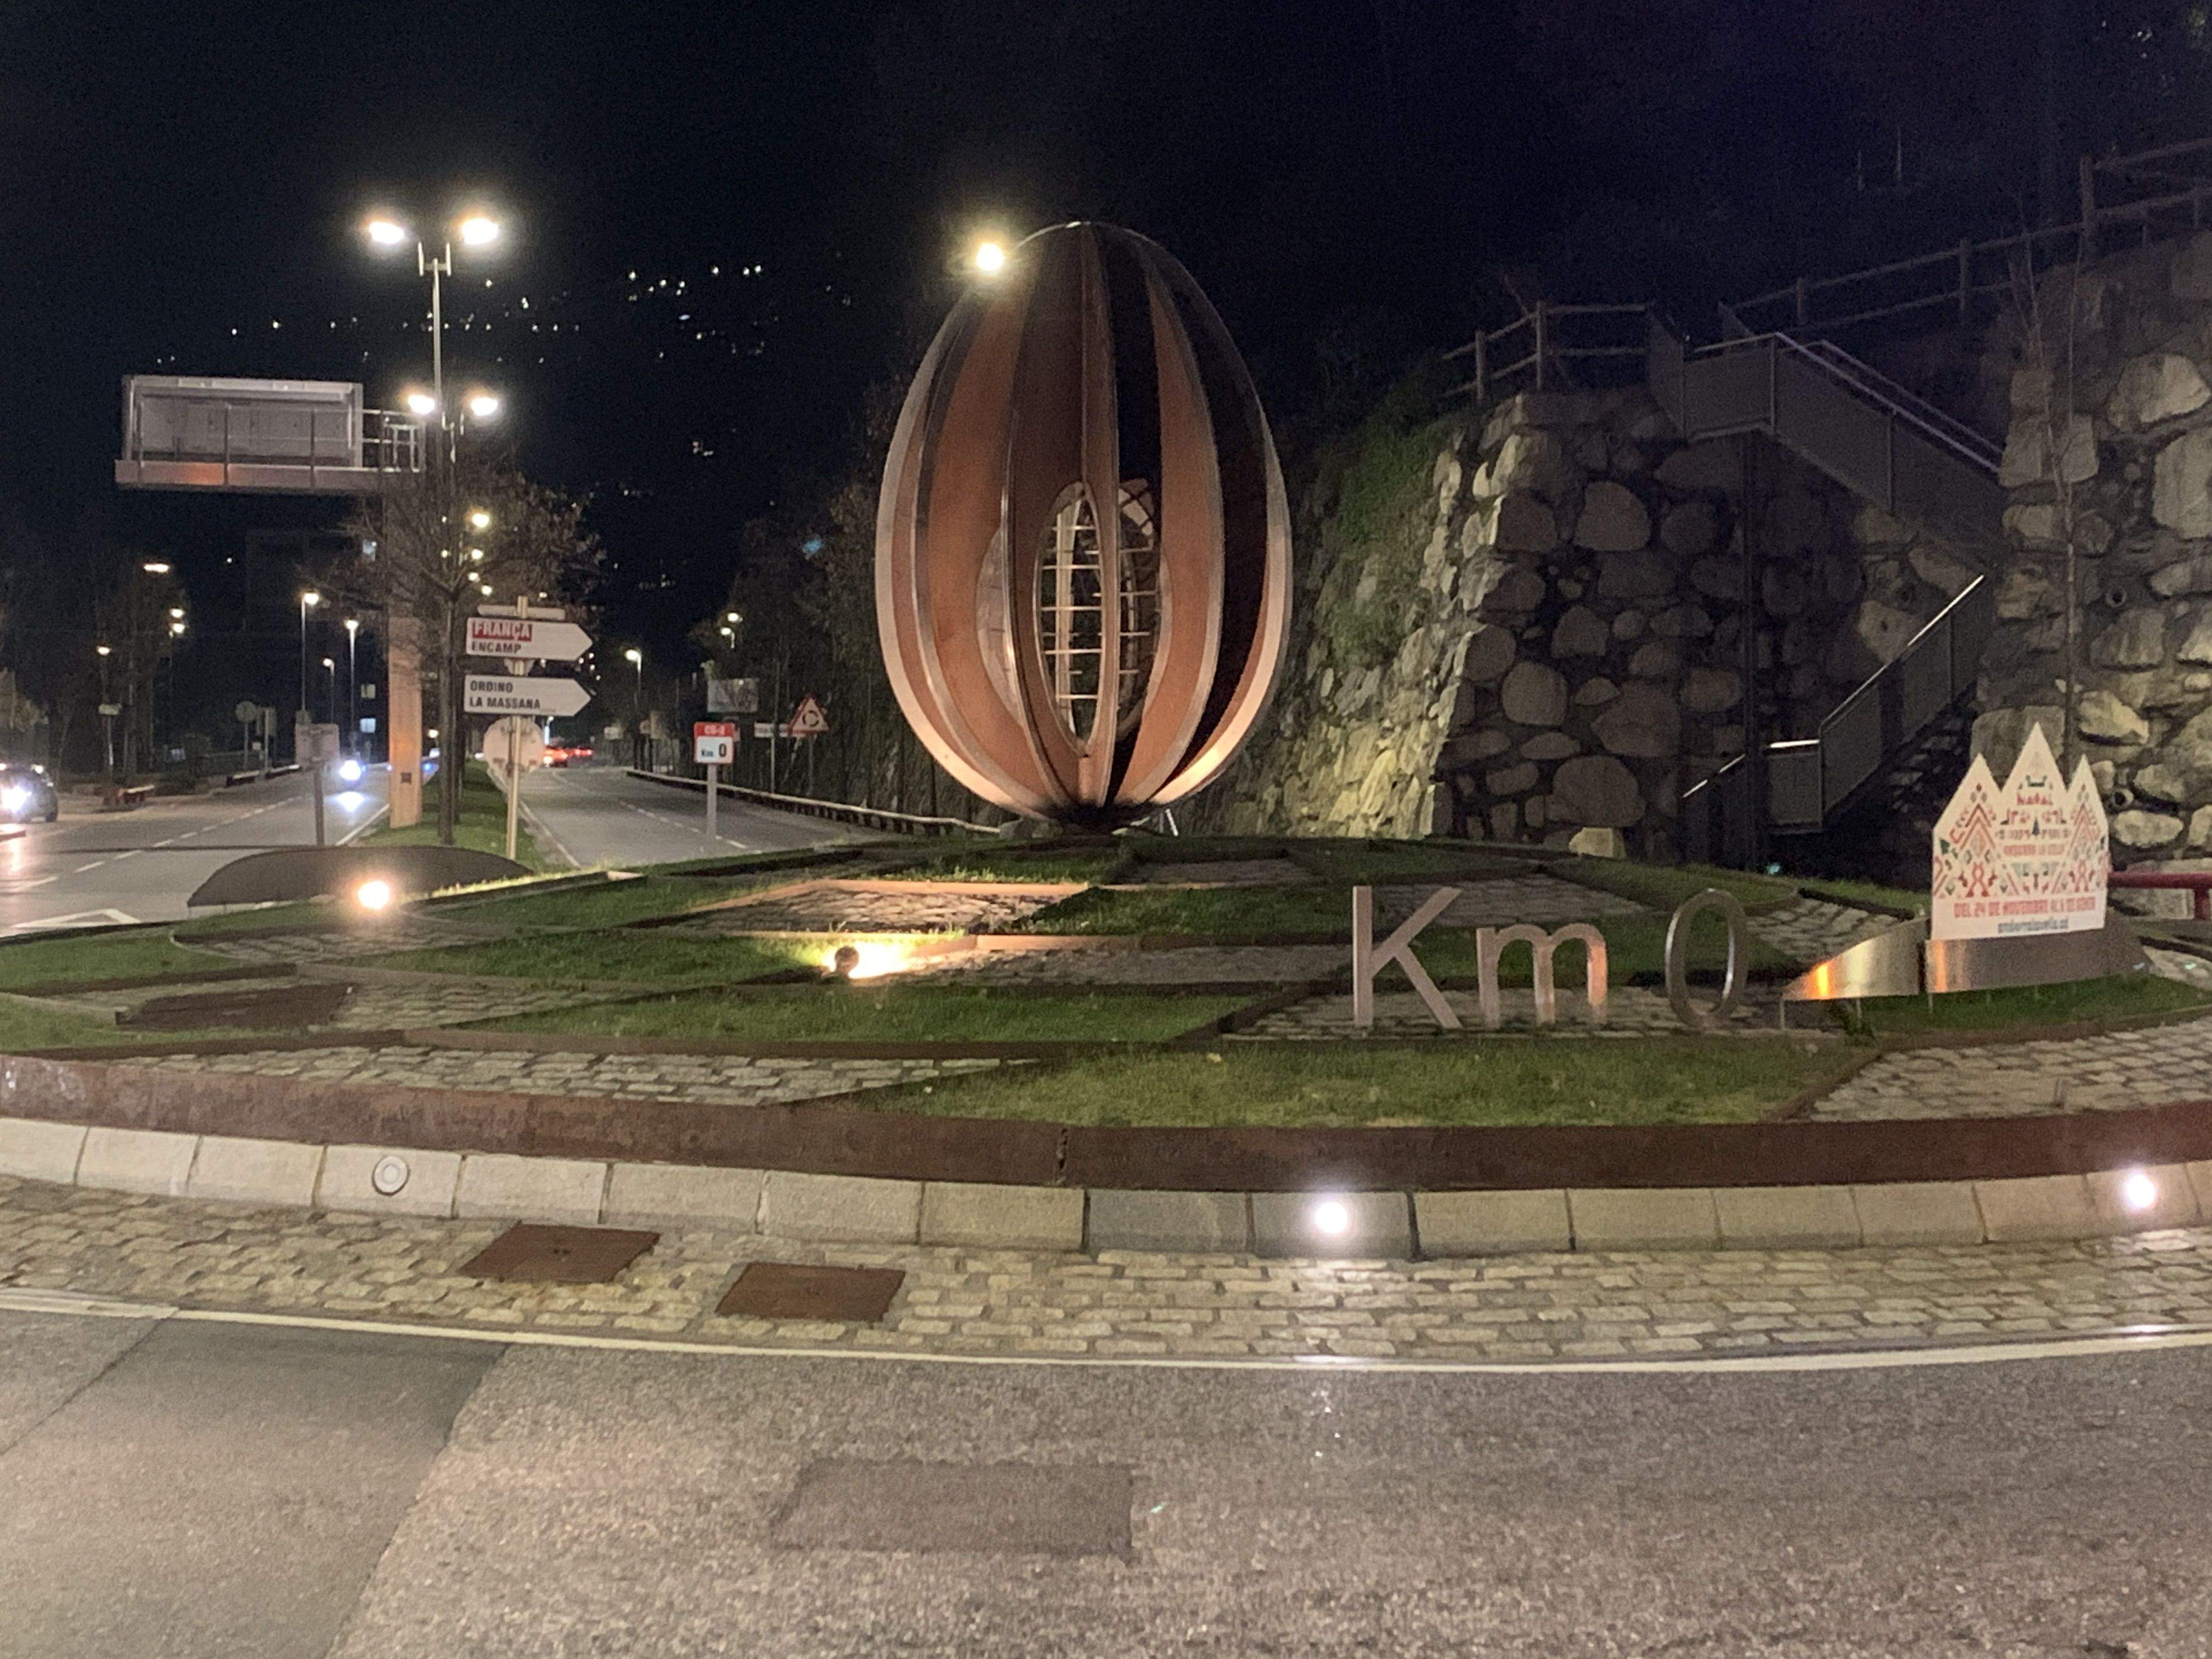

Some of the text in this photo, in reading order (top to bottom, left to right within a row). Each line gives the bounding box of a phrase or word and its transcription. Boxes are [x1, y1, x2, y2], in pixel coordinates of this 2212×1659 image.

[473, 622, 532, 641] FRANÇA
[472, 641, 521, 653] ENCAMP
[470, 680, 514, 693] ORDINO
[470, 697, 540, 709] LA MASSANA
[719, 743, 727, 757] 0
[1352, 884, 1748, 1029] Km 0
